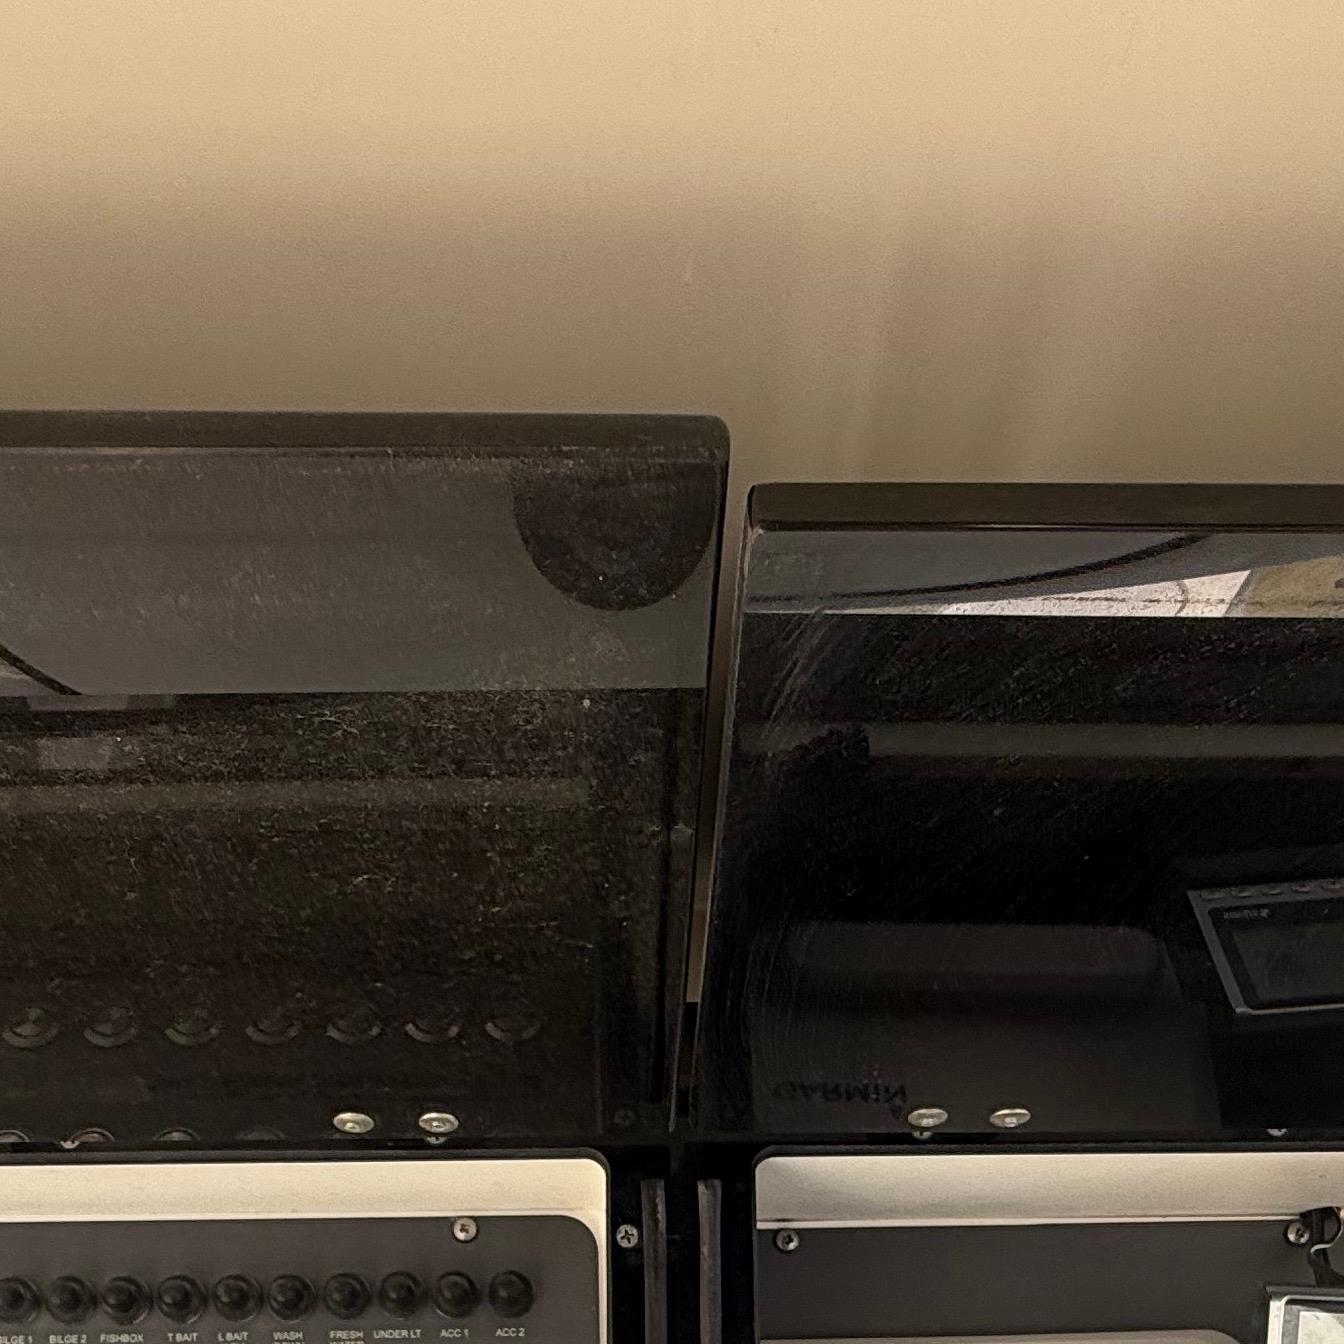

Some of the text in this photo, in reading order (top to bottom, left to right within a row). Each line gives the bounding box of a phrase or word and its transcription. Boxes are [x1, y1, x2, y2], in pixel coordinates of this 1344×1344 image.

[175, 1332, 198, 1343] BAIT
[225, 1331, 249, 1342] BAIT
[273, 1331, 303, 1341] WASH
[329, 1330, 364, 1340] FRESH
[373, 1328, 422, 1340] UNDER LT
[440, 1328, 462, 1338] ACC
[495, 1327, 526, 1338] ACC 2
[49, 1335, 79, 1344] BILGE
[100, 1333, 144, 1344] FISHBOX
